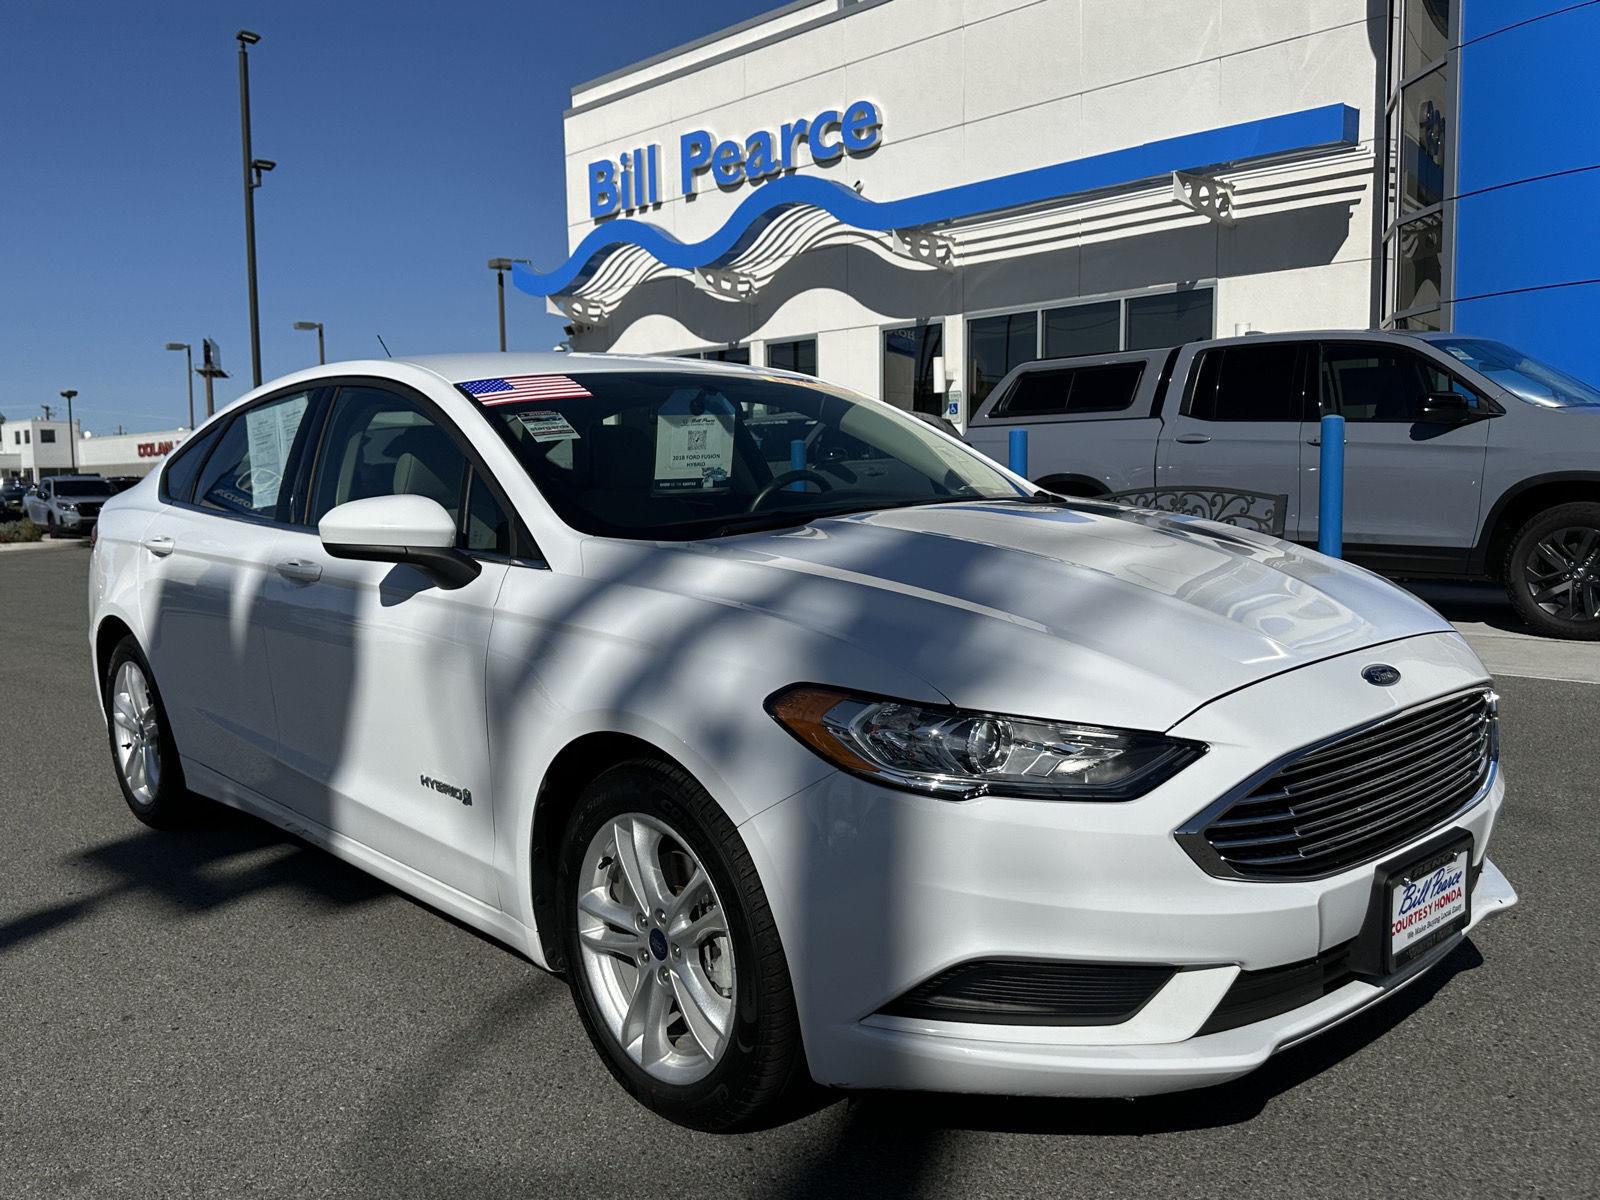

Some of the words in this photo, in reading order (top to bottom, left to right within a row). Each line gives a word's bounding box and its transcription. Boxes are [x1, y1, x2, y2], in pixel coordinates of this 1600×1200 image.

[588, 144, 660, 218] Bill
[680, 101, 881, 195] Pearce
[420, 774, 462, 801] HYBRID
[1391, 903, 1434, 937] COURTESY
[1434, 886, 1462, 912] HONDA
[1399, 878, 1433, 915] Bill
[1429, 867, 1463, 898] Pearce
